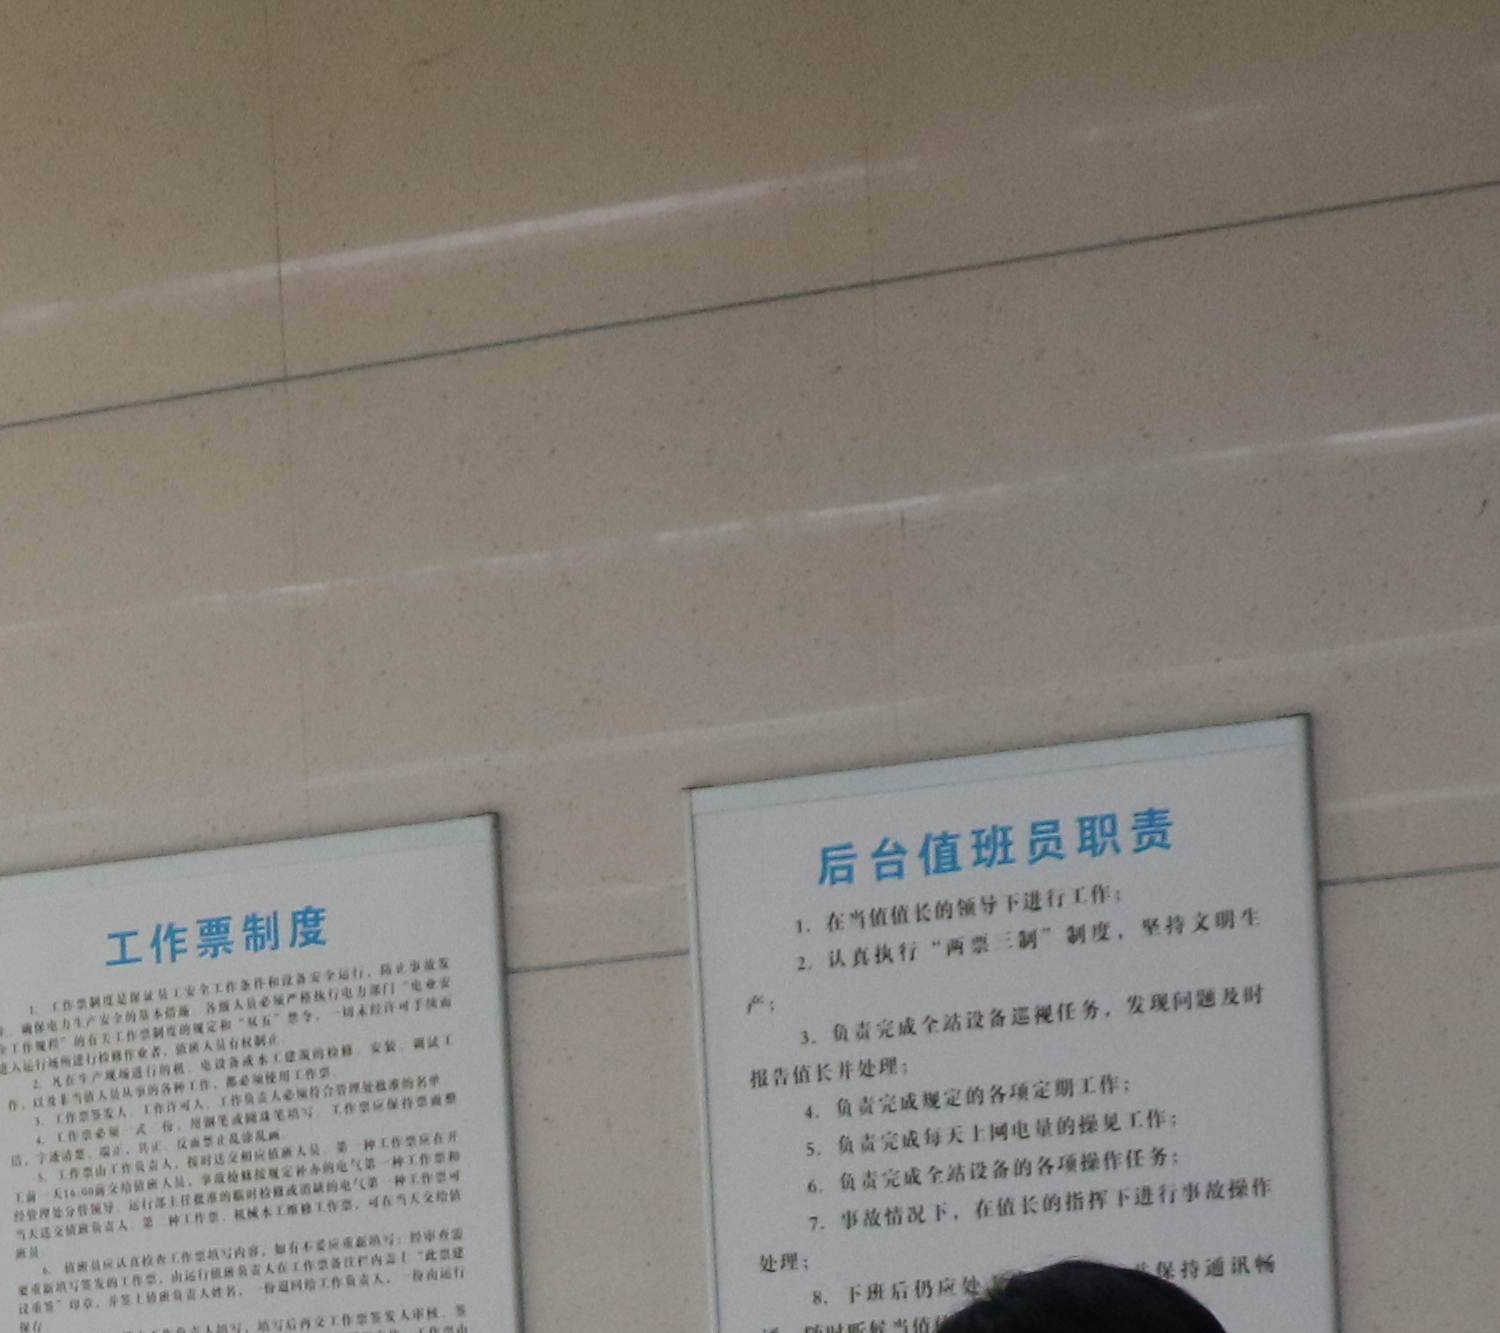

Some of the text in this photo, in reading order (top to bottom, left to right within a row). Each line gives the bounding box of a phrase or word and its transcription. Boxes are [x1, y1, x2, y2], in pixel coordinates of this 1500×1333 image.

[815, 804, 1174, 890] 后台值班员职责
[104, 903, 328, 971] 工作票制度
[794, 879, 1121, 938] 1.在当值值长的领导下进行工作；
[745, 992, 776, 1014] 产；
[748, 1053, 908, 1091] 报告值长并处理；
[802, 1069, 1130, 1124] 4.负责完成规定的各项定期工作；
[804, 1103, 1177, 1161] 5.负责完成每天上网电量的操见工作；
[805, 1141, 1179, 1199] 6.负责完成全站设备的各项操作任务；
[757, 1250, 809, 1274] 处理；
